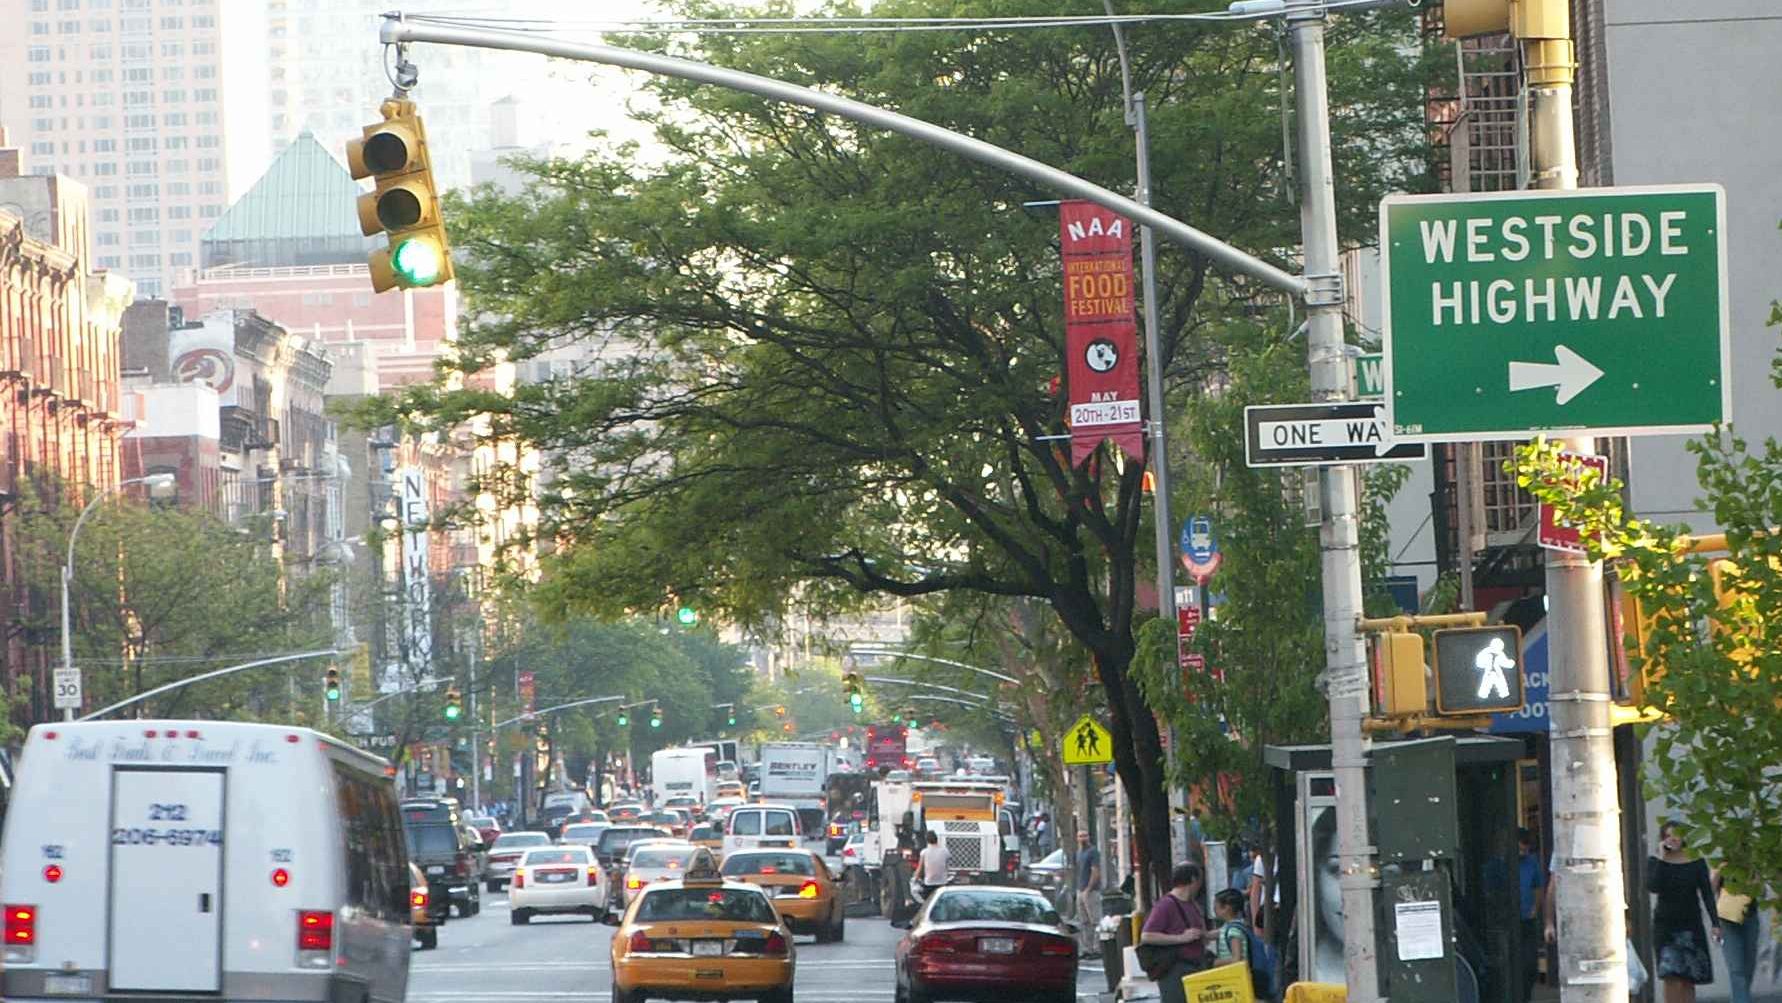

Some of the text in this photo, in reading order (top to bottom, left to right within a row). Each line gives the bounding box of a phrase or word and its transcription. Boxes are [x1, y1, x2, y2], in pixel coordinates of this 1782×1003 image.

[1067, 217, 1123, 241] NAA
[1420, 211, 1688, 263] WESTSIDE
[1069, 273, 1128, 299] FOOD
[1071, 297, 1129, 316] FESTIVAL
[1432, 273, 1677, 326] HIGHWAY
[1090, 391, 1118, 402] MAY
[1273, 421, 1387, 446] ONE WA
[57, 683, 78, 697] 30
[150, 803, 187, 821] 212
[112, 828, 224, 846] 206-6974
